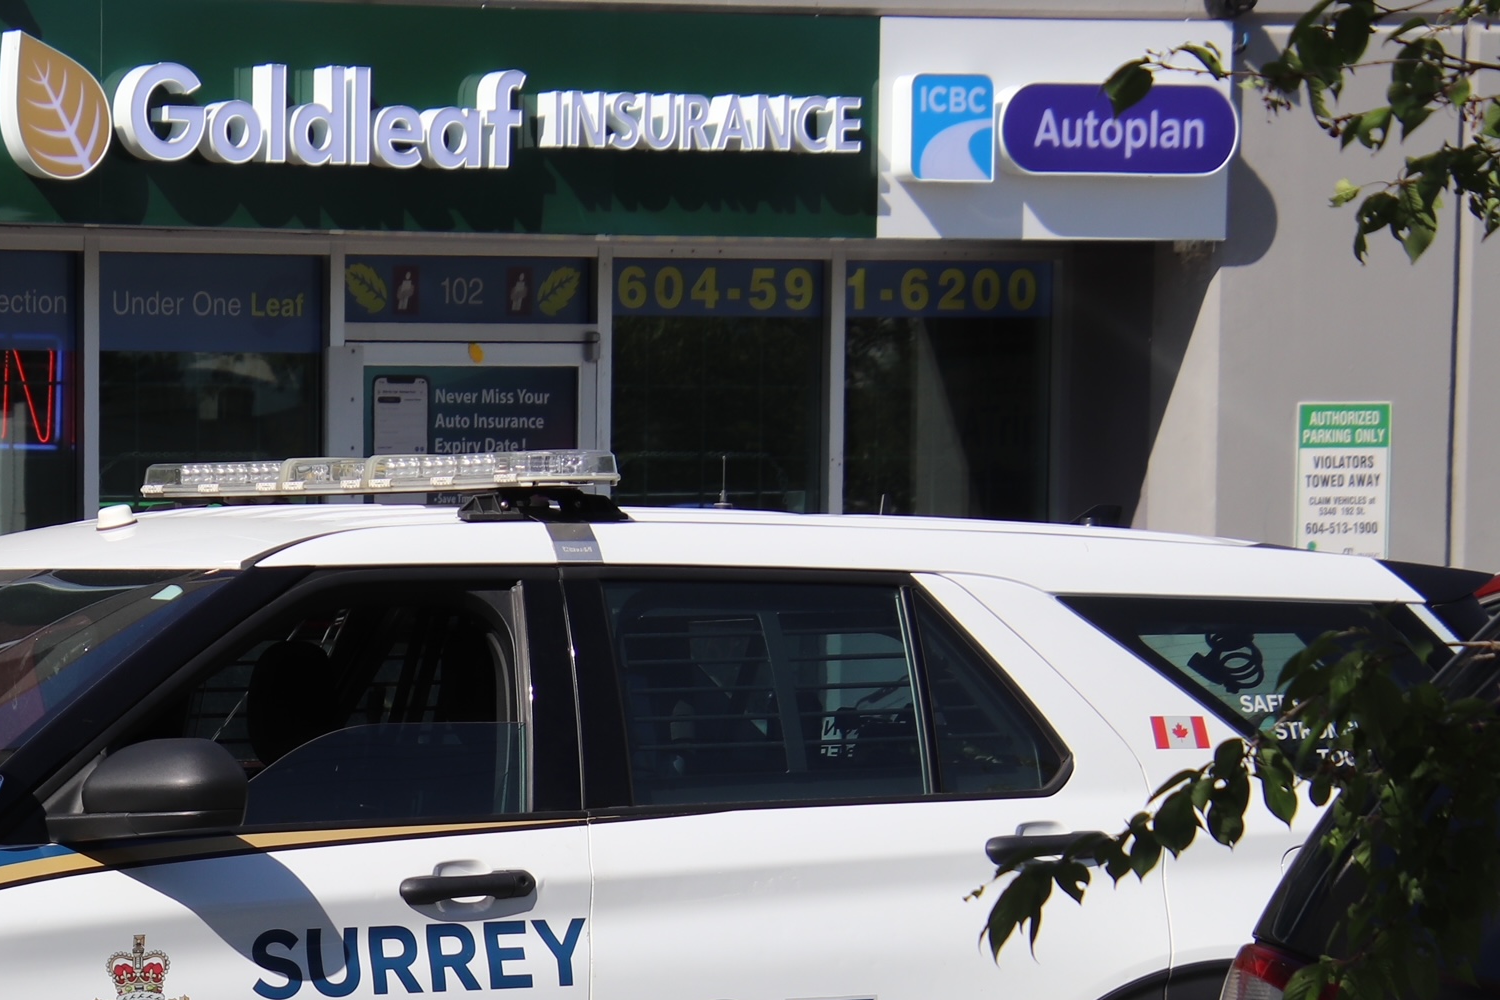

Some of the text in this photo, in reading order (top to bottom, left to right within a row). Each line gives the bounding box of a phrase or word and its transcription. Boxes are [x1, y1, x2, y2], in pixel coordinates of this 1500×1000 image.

[920, 85, 987, 114] ICBC
[112, 62, 863, 169] Goldleaf INSURANCE
[1034, 108, 1205, 158] Autoplan
[440, 277, 484, 305] 102
[112, 290, 304, 317] Under One Leaf
[435, 389, 477, 404] Never
[482, 389, 514, 404] Miss
[517, 389, 550, 404] Your
[435, 414, 544, 429] Auto Insurance
[1309, 411, 1380, 426] AUTHORIZED
[1302, 428, 1386, 443] PARKING ONLY
[435, 438, 481, 453] Expiry
[1313, 455, 1374, 469] VIOLATORS
[1305, 473, 1381, 488] TOWED AWAY
[1309, 497, 1331, 505] CLAIM
[1334, 497, 1367, 505] VEHICLES
[1305, 522, 1378, 535] 604-513-1900
[251, 917, 587, 1000] SURREY
